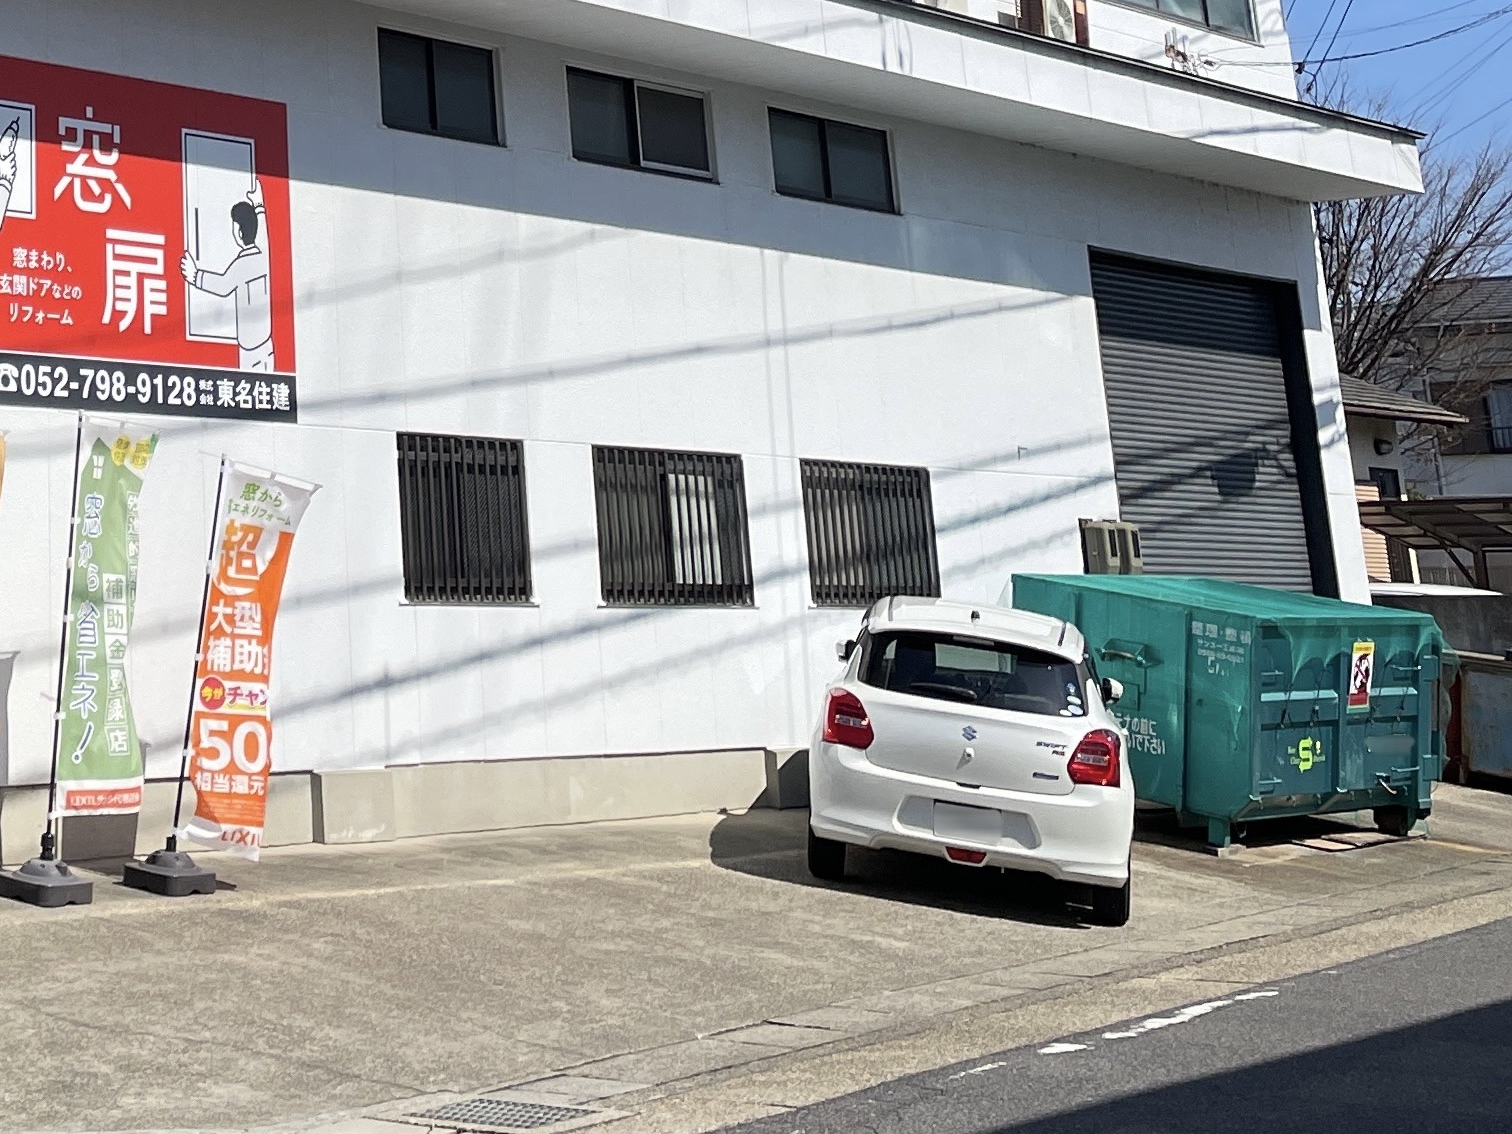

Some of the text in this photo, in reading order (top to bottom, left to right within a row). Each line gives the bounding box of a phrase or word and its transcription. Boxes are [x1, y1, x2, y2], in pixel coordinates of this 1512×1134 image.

[54, 106, 131, 214] 窓
[12, 247, 72, 273] 窓まわり、
[102, 228, 168, 335] 扉
[10, 303, 74, 325] リフォーム
[20, 363, 197, 407] 052-798-9128
[216, 378, 290, 411] 東名住建
[240, 483, 283, 507] 窓から
[215, 519, 265, 593] 超
[210, 599, 262, 636] 大型
[196, 718, 267, 774] 50
